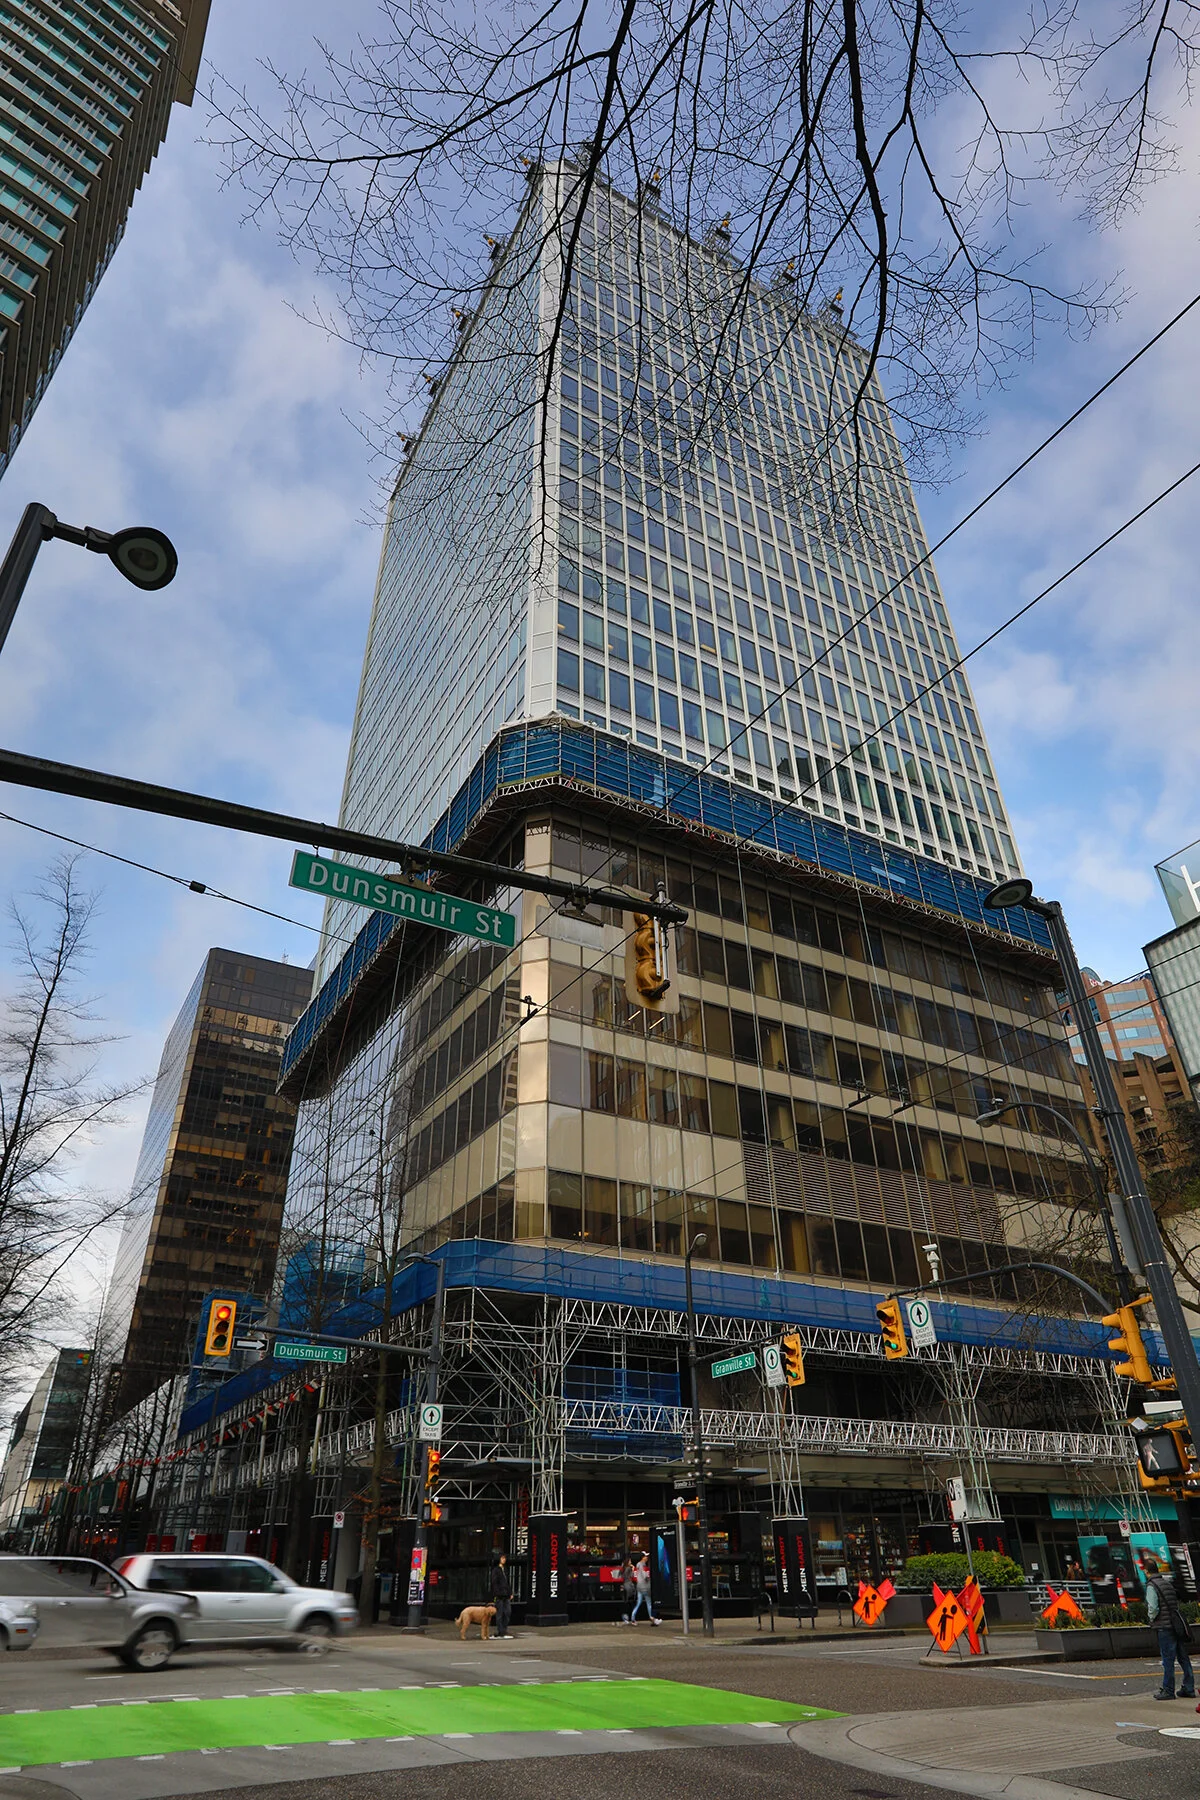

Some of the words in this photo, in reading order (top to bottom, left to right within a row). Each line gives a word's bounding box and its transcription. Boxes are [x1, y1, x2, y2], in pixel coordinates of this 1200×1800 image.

[308, 861, 461, 925] Dunsmuir
[475, 911, 503, 939] St
[279, 1345, 329, 1358] Dunsmuir
[332, 1350, 343, 1360] St
[715, 1359, 743, 1375] Granville
[744, 1357, 752, 1367] St
[550, 1532, 559, 1598] MEINHARDT
[778, 1535, 789, 1593] MEINHARDT
[796, 1535, 808, 1593] MEINHARDT
